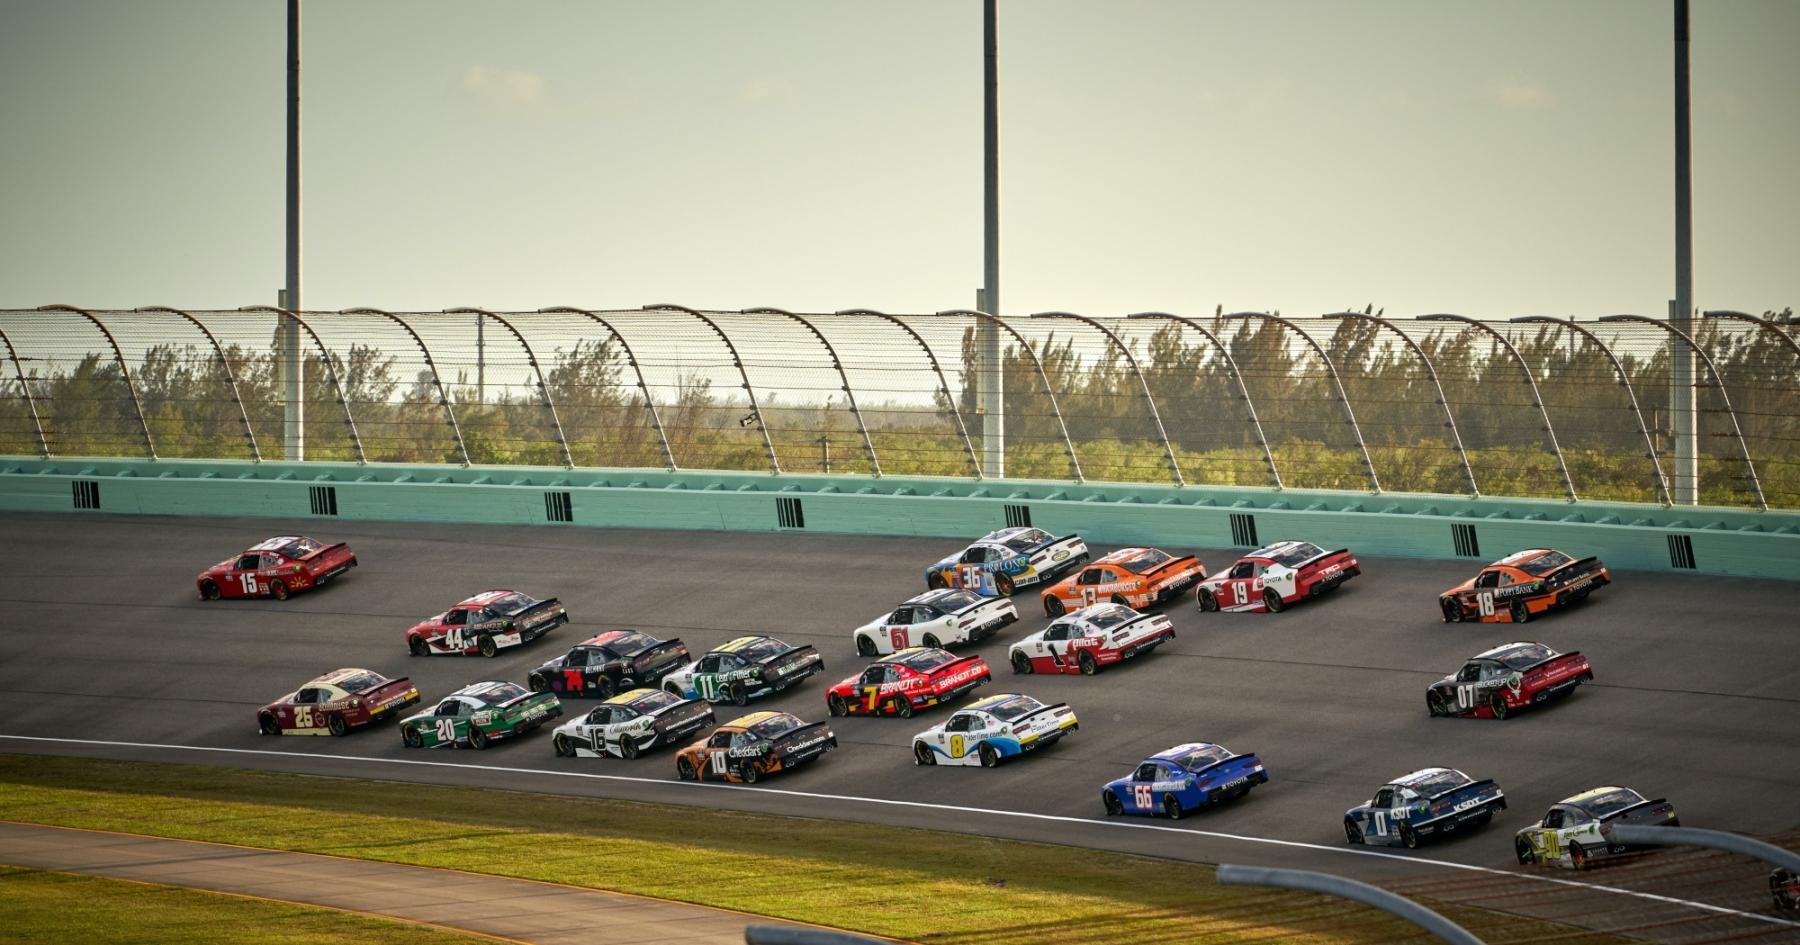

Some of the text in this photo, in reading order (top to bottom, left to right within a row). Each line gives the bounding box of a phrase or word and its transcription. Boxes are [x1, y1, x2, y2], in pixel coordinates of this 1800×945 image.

[239, 573, 257, 594] 15
[962, 567, 981, 589] 36
[1264, 576, 1282, 584] TOYOTA
[1326, 571, 1344, 581] TOYOTA
[1081, 587, 1097, 607] 13
[1232, 582, 1248, 604] 19
[1476, 592, 1494, 616] 18
[445, 628, 464, 650] 44
[891, 627, 909, 650] 61
[1048, 644, 1065, 667] 1
[700, 676, 714, 699] 11
[880, 678, 916, 694] BRANDT
[1457, 685, 1474, 709] 07
[864, 687, 877, 710] 7
[294, 706, 313, 728] 26
[436, 718, 455, 741] 20
[589, 727, 606, 751] 16
[950, 735, 964, 758] 8
[710, 751, 727, 774] 10
[1226, 776, 1248, 789] TOYOTA
[1135, 785, 1152, 810] 66
[1453, 797, 1480, 812] KSDT
[1374, 812, 1387, 836] 0
[1390, 806, 1412, 820] KSDT
